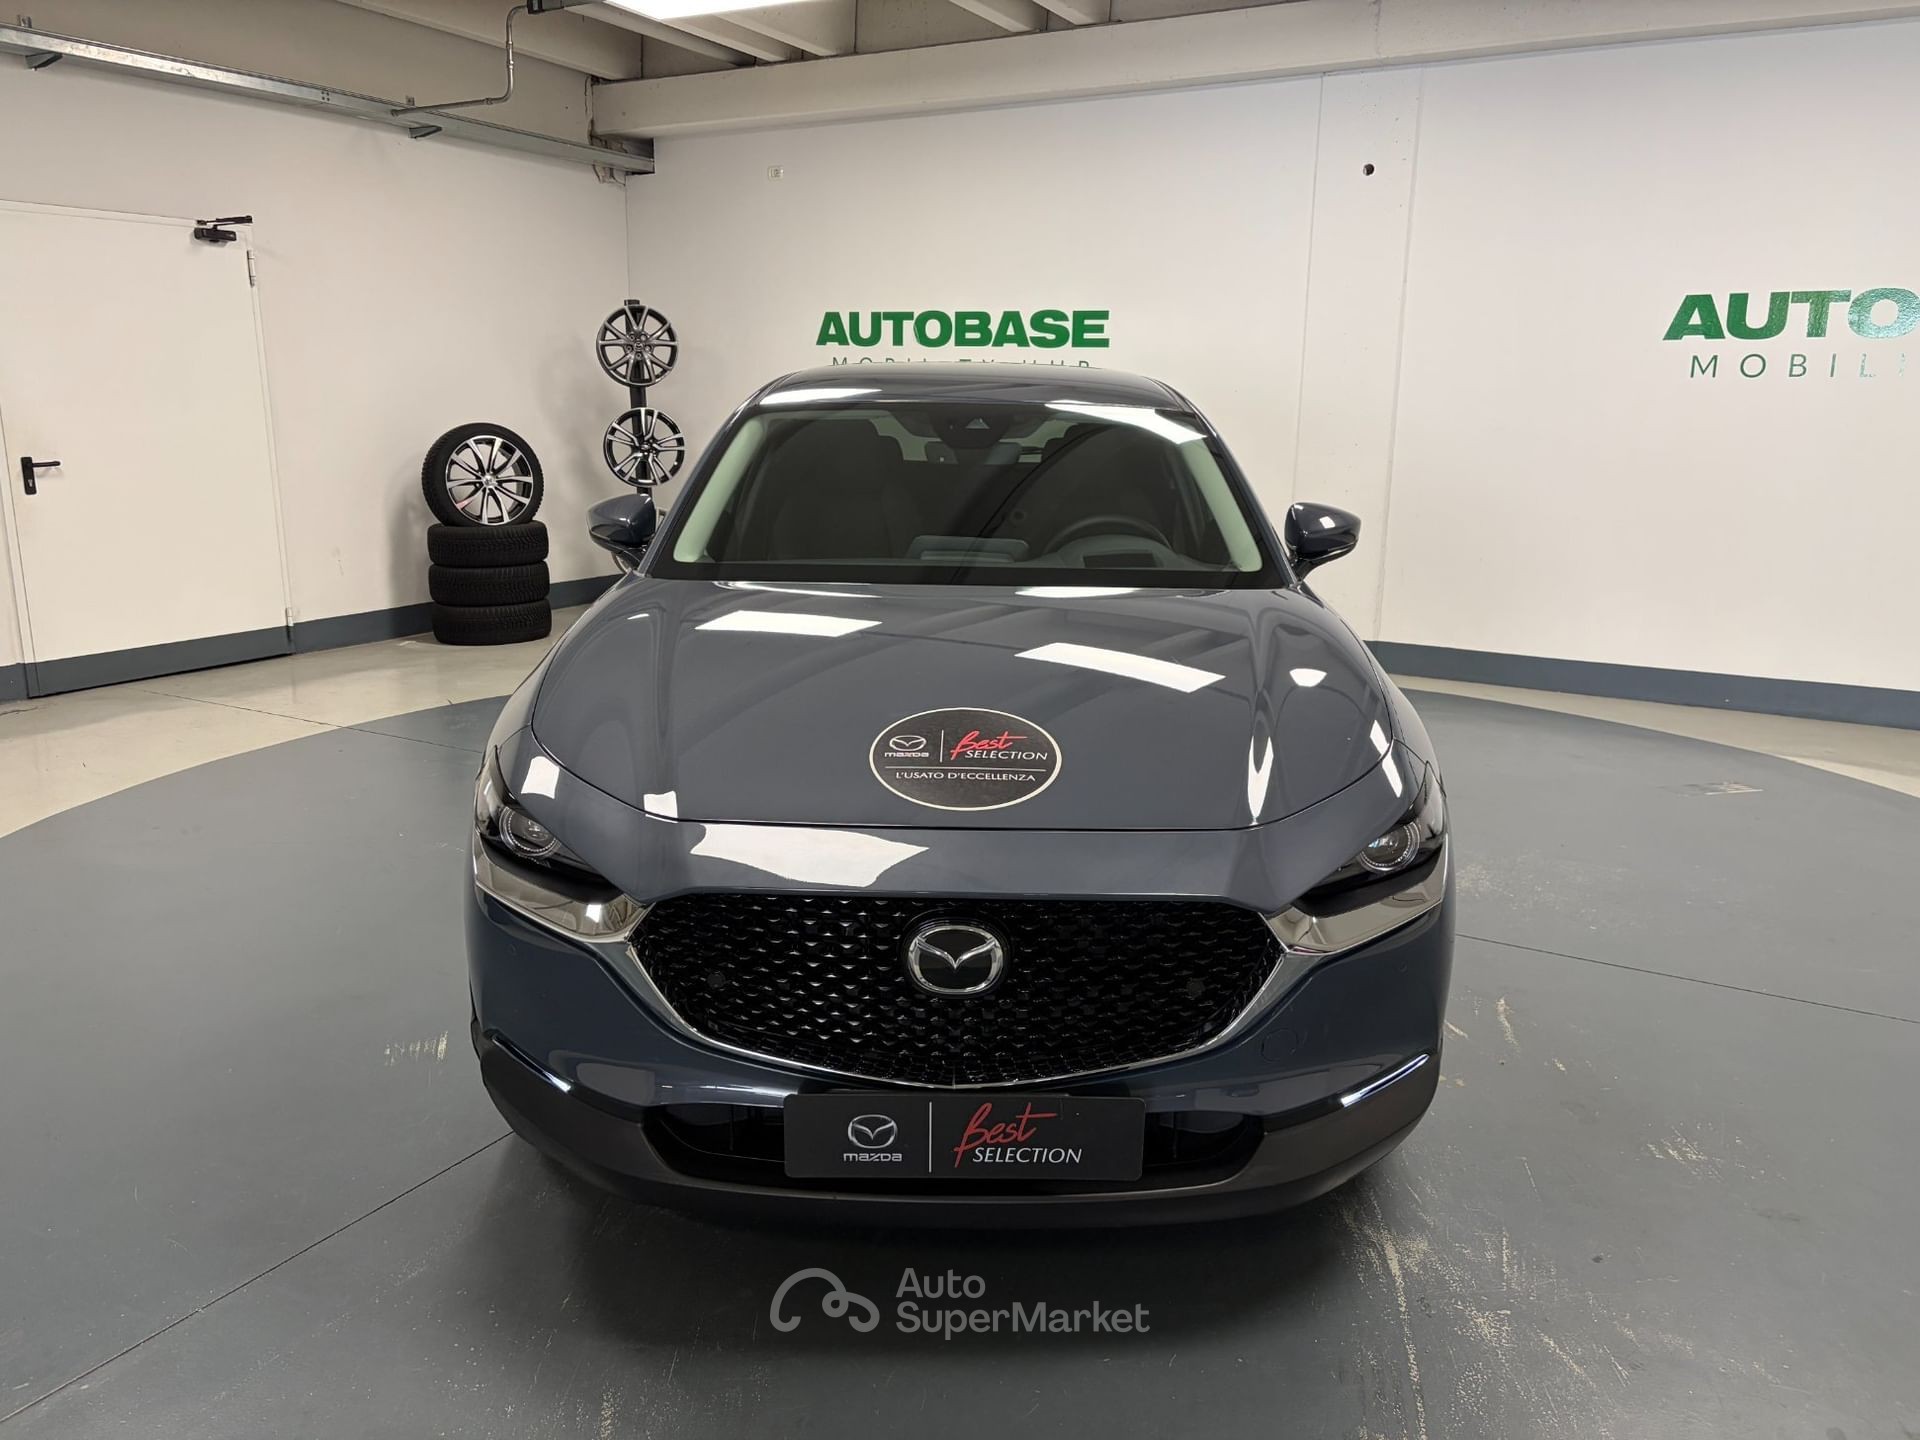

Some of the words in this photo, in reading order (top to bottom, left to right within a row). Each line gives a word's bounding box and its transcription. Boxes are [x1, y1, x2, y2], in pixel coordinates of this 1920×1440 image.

[815, 309, 1110, 349] AUTOBASE
[1662, 287, 1920, 341] AUTO
[950, 730, 1029, 761] Best
[964, 749, 1048, 761] SELECTION
[896, 771, 944, 780] L'USATO
[947, 772, 1036, 782] D'ECCELLENZA
[952, 1101, 1058, 1168] Best
[972, 1146, 1083, 1165] SELECTION
